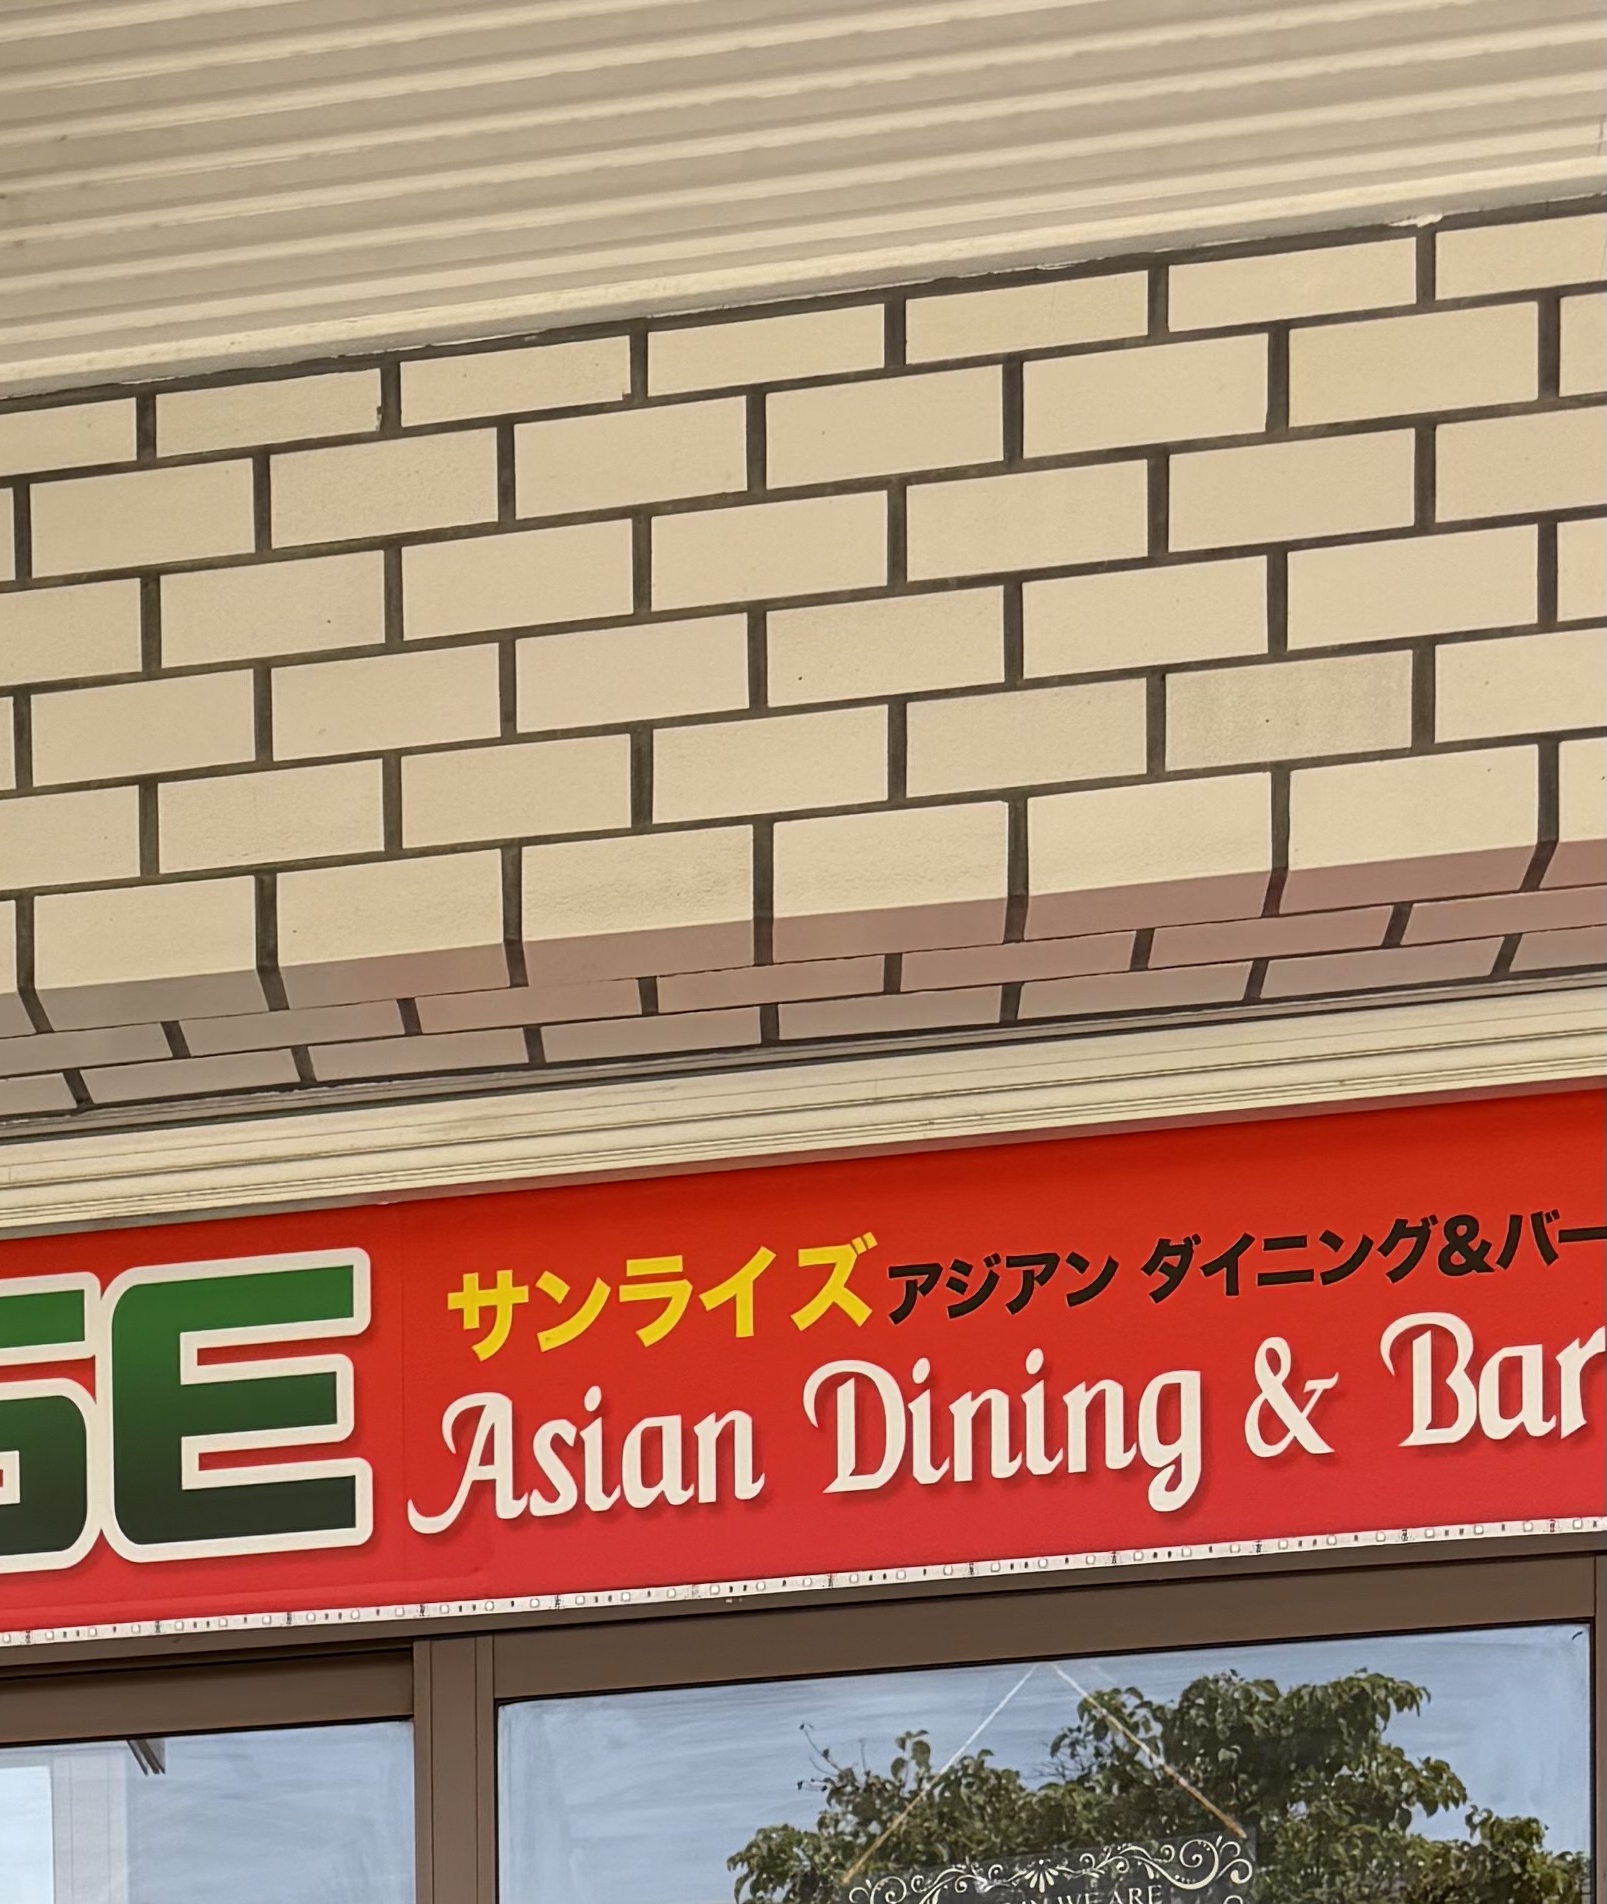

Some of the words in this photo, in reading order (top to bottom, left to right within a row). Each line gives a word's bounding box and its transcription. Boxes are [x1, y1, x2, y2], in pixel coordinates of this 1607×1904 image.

[447, 1231, 883, 1362] サンライズ
[886, 1250, 1120, 1329] アジアン
[407, 1384, 766, 1536] Asian
[803, 1347, 1203, 1514] Dining
[1243, 1335, 1340, 1462] &
[1379, 1310, 1607, 1449] Bar
